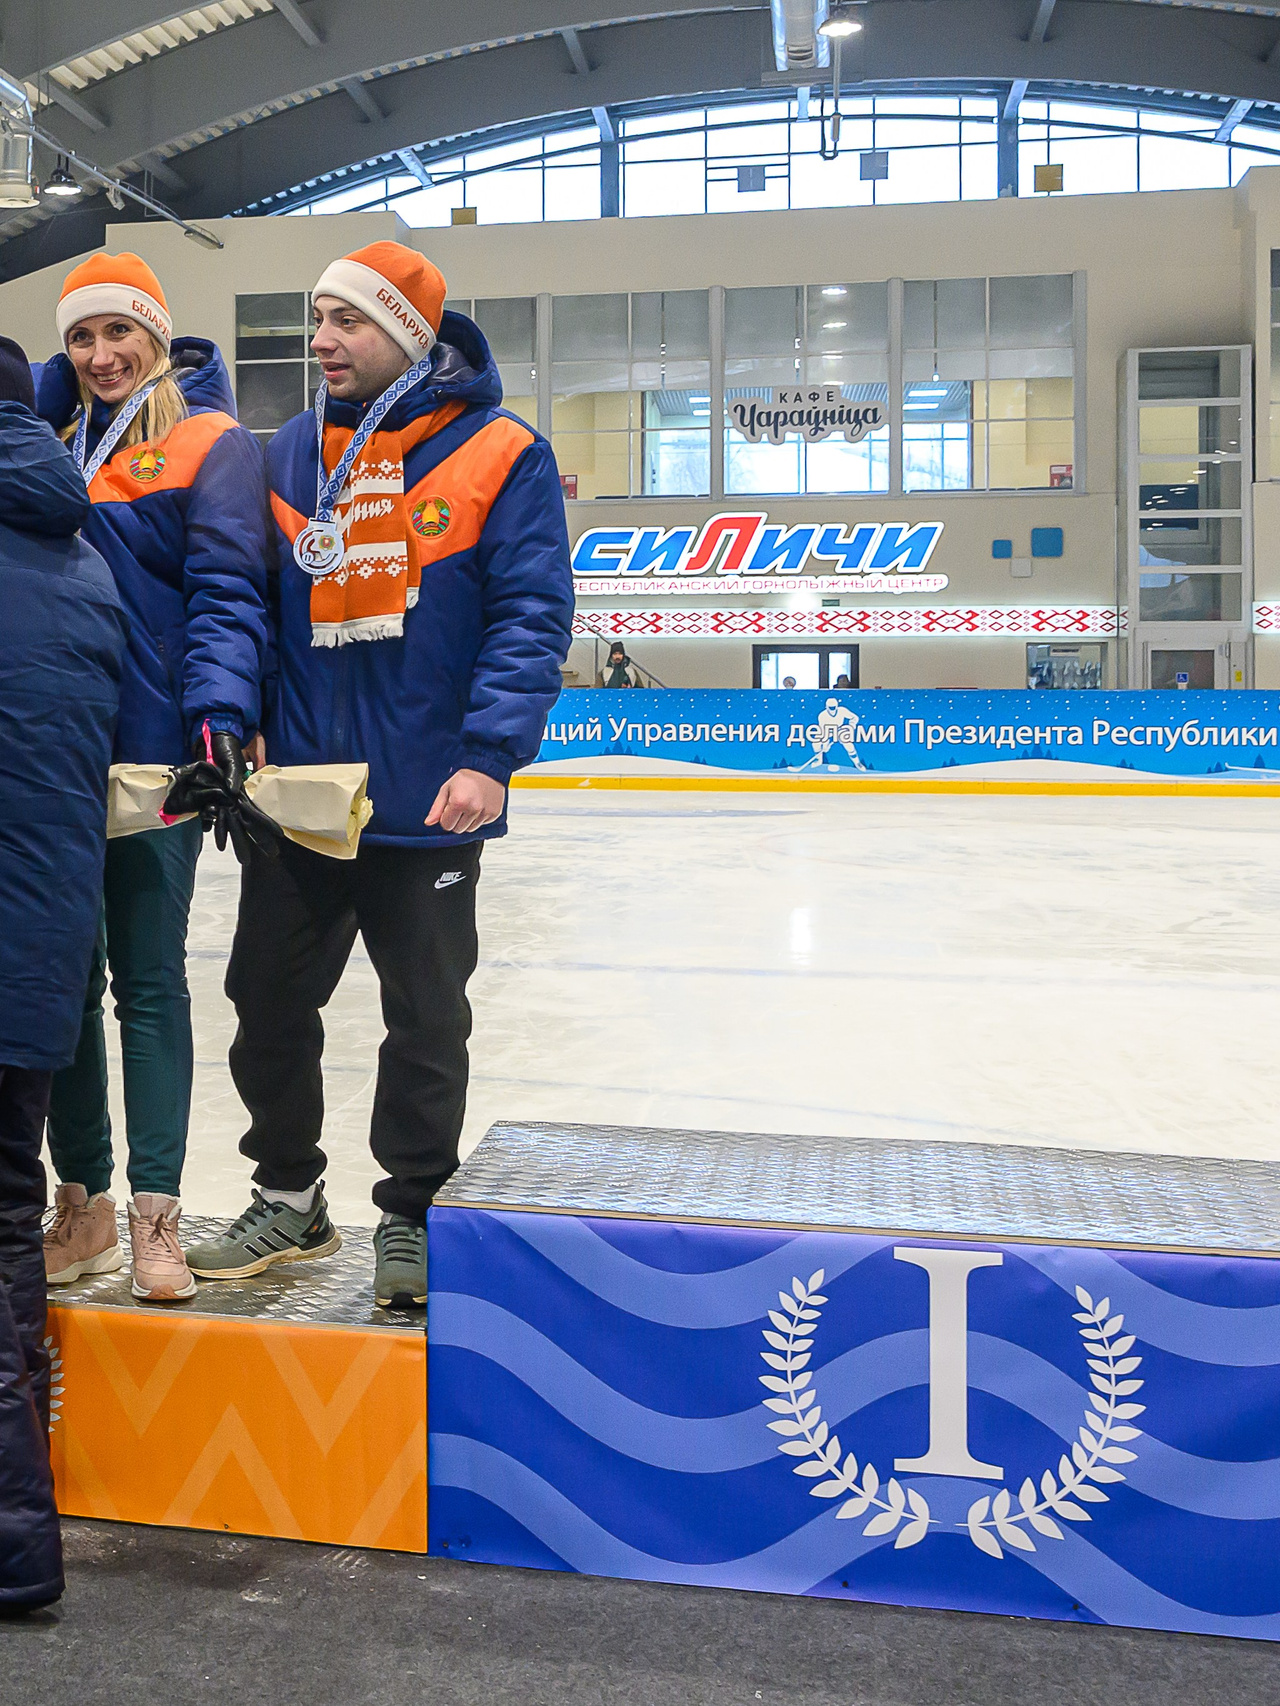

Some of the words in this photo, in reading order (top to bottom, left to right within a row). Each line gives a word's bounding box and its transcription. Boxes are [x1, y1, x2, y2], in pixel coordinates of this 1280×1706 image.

[132, 300, 171, 344] БЕЛАРУС
[376, 288, 431, 349] БЕЛАРУСЬ
[779, 391, 835, 403] КАФЕ
[733, 403, 882, 439] Чараўніца
[743, 577, 883, 590] ГОРНОЛЫЖНЫЙ
[888, 578, 944, 589] ЦЕНТР
[609, 717, 780, 747] Управления
[786, 723, 896, 747] делами
[904, 718, 1084, 750] Президента
[1092, 719, 1278, 752] Республики
[440, 871, 462, 881] NIKE
